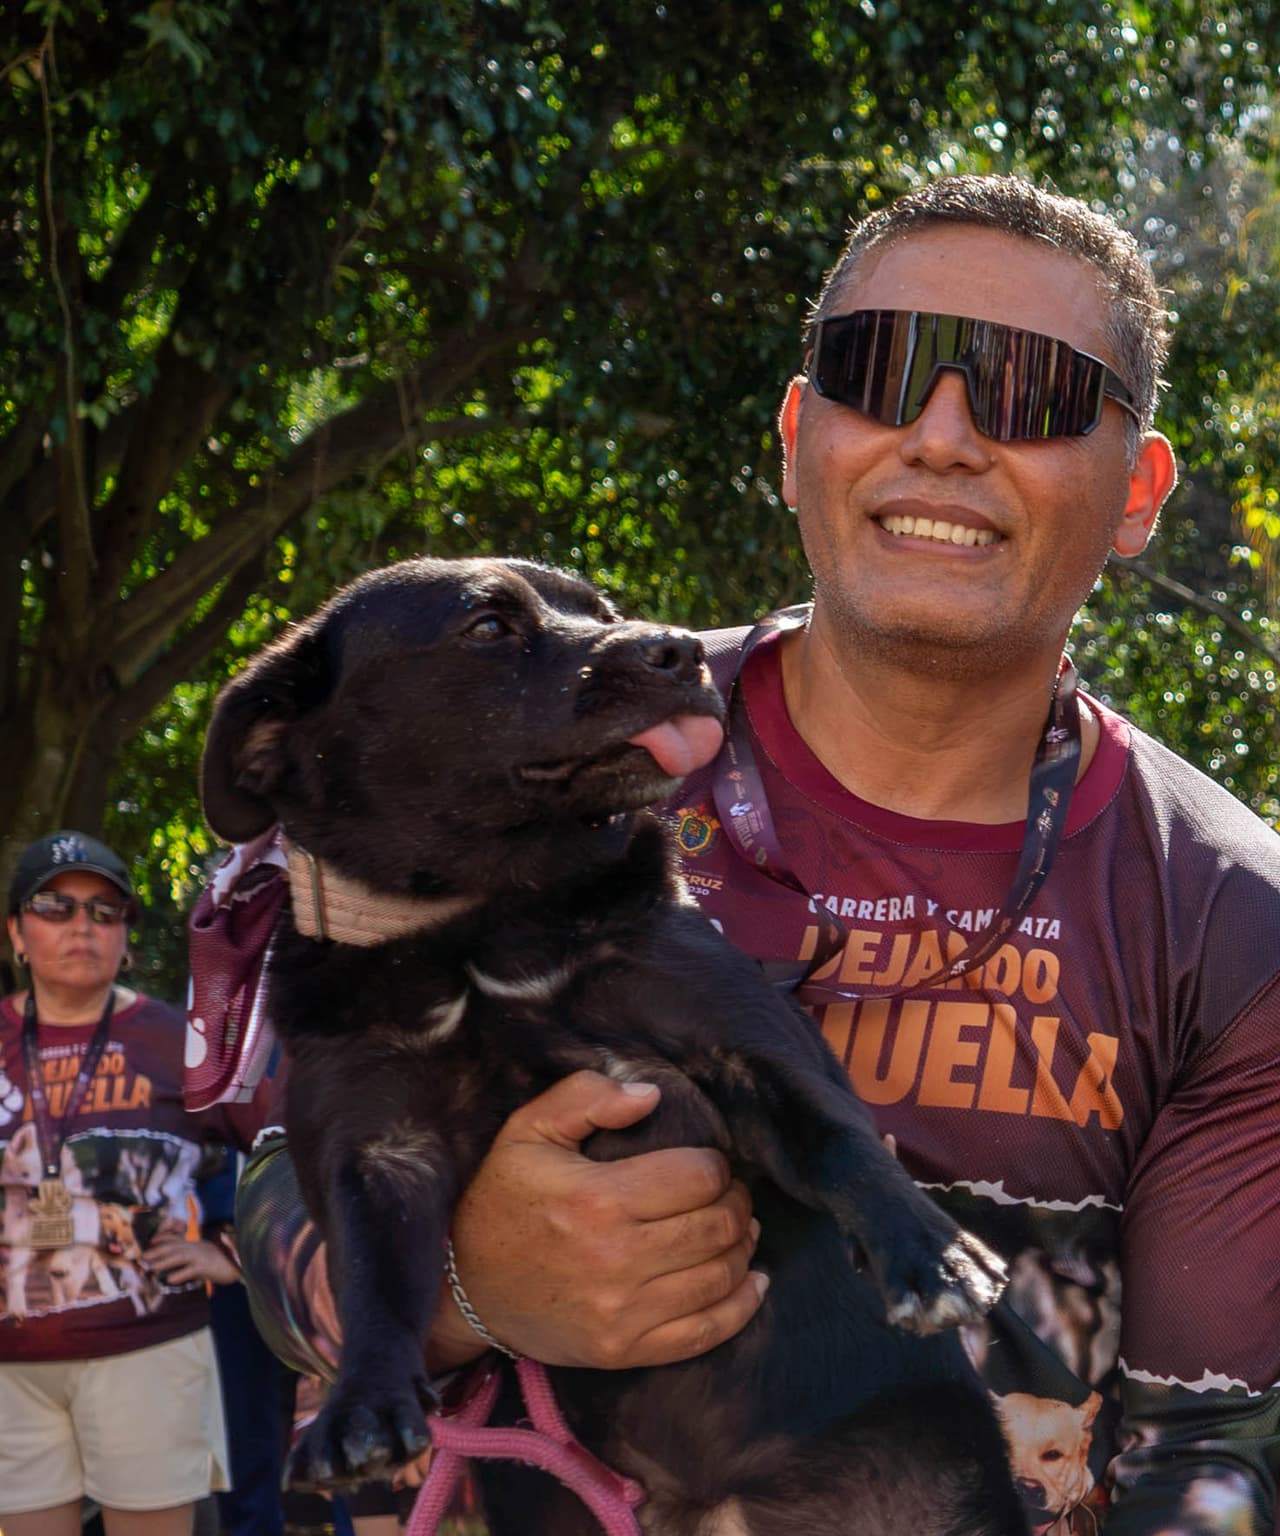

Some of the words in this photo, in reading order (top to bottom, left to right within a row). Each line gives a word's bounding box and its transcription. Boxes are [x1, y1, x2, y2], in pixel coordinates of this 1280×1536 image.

[808, 894, 916, 921] CARRERA
[919, 899, 938, 917] Y
[946, 908, 1061, 940] CAMATA
